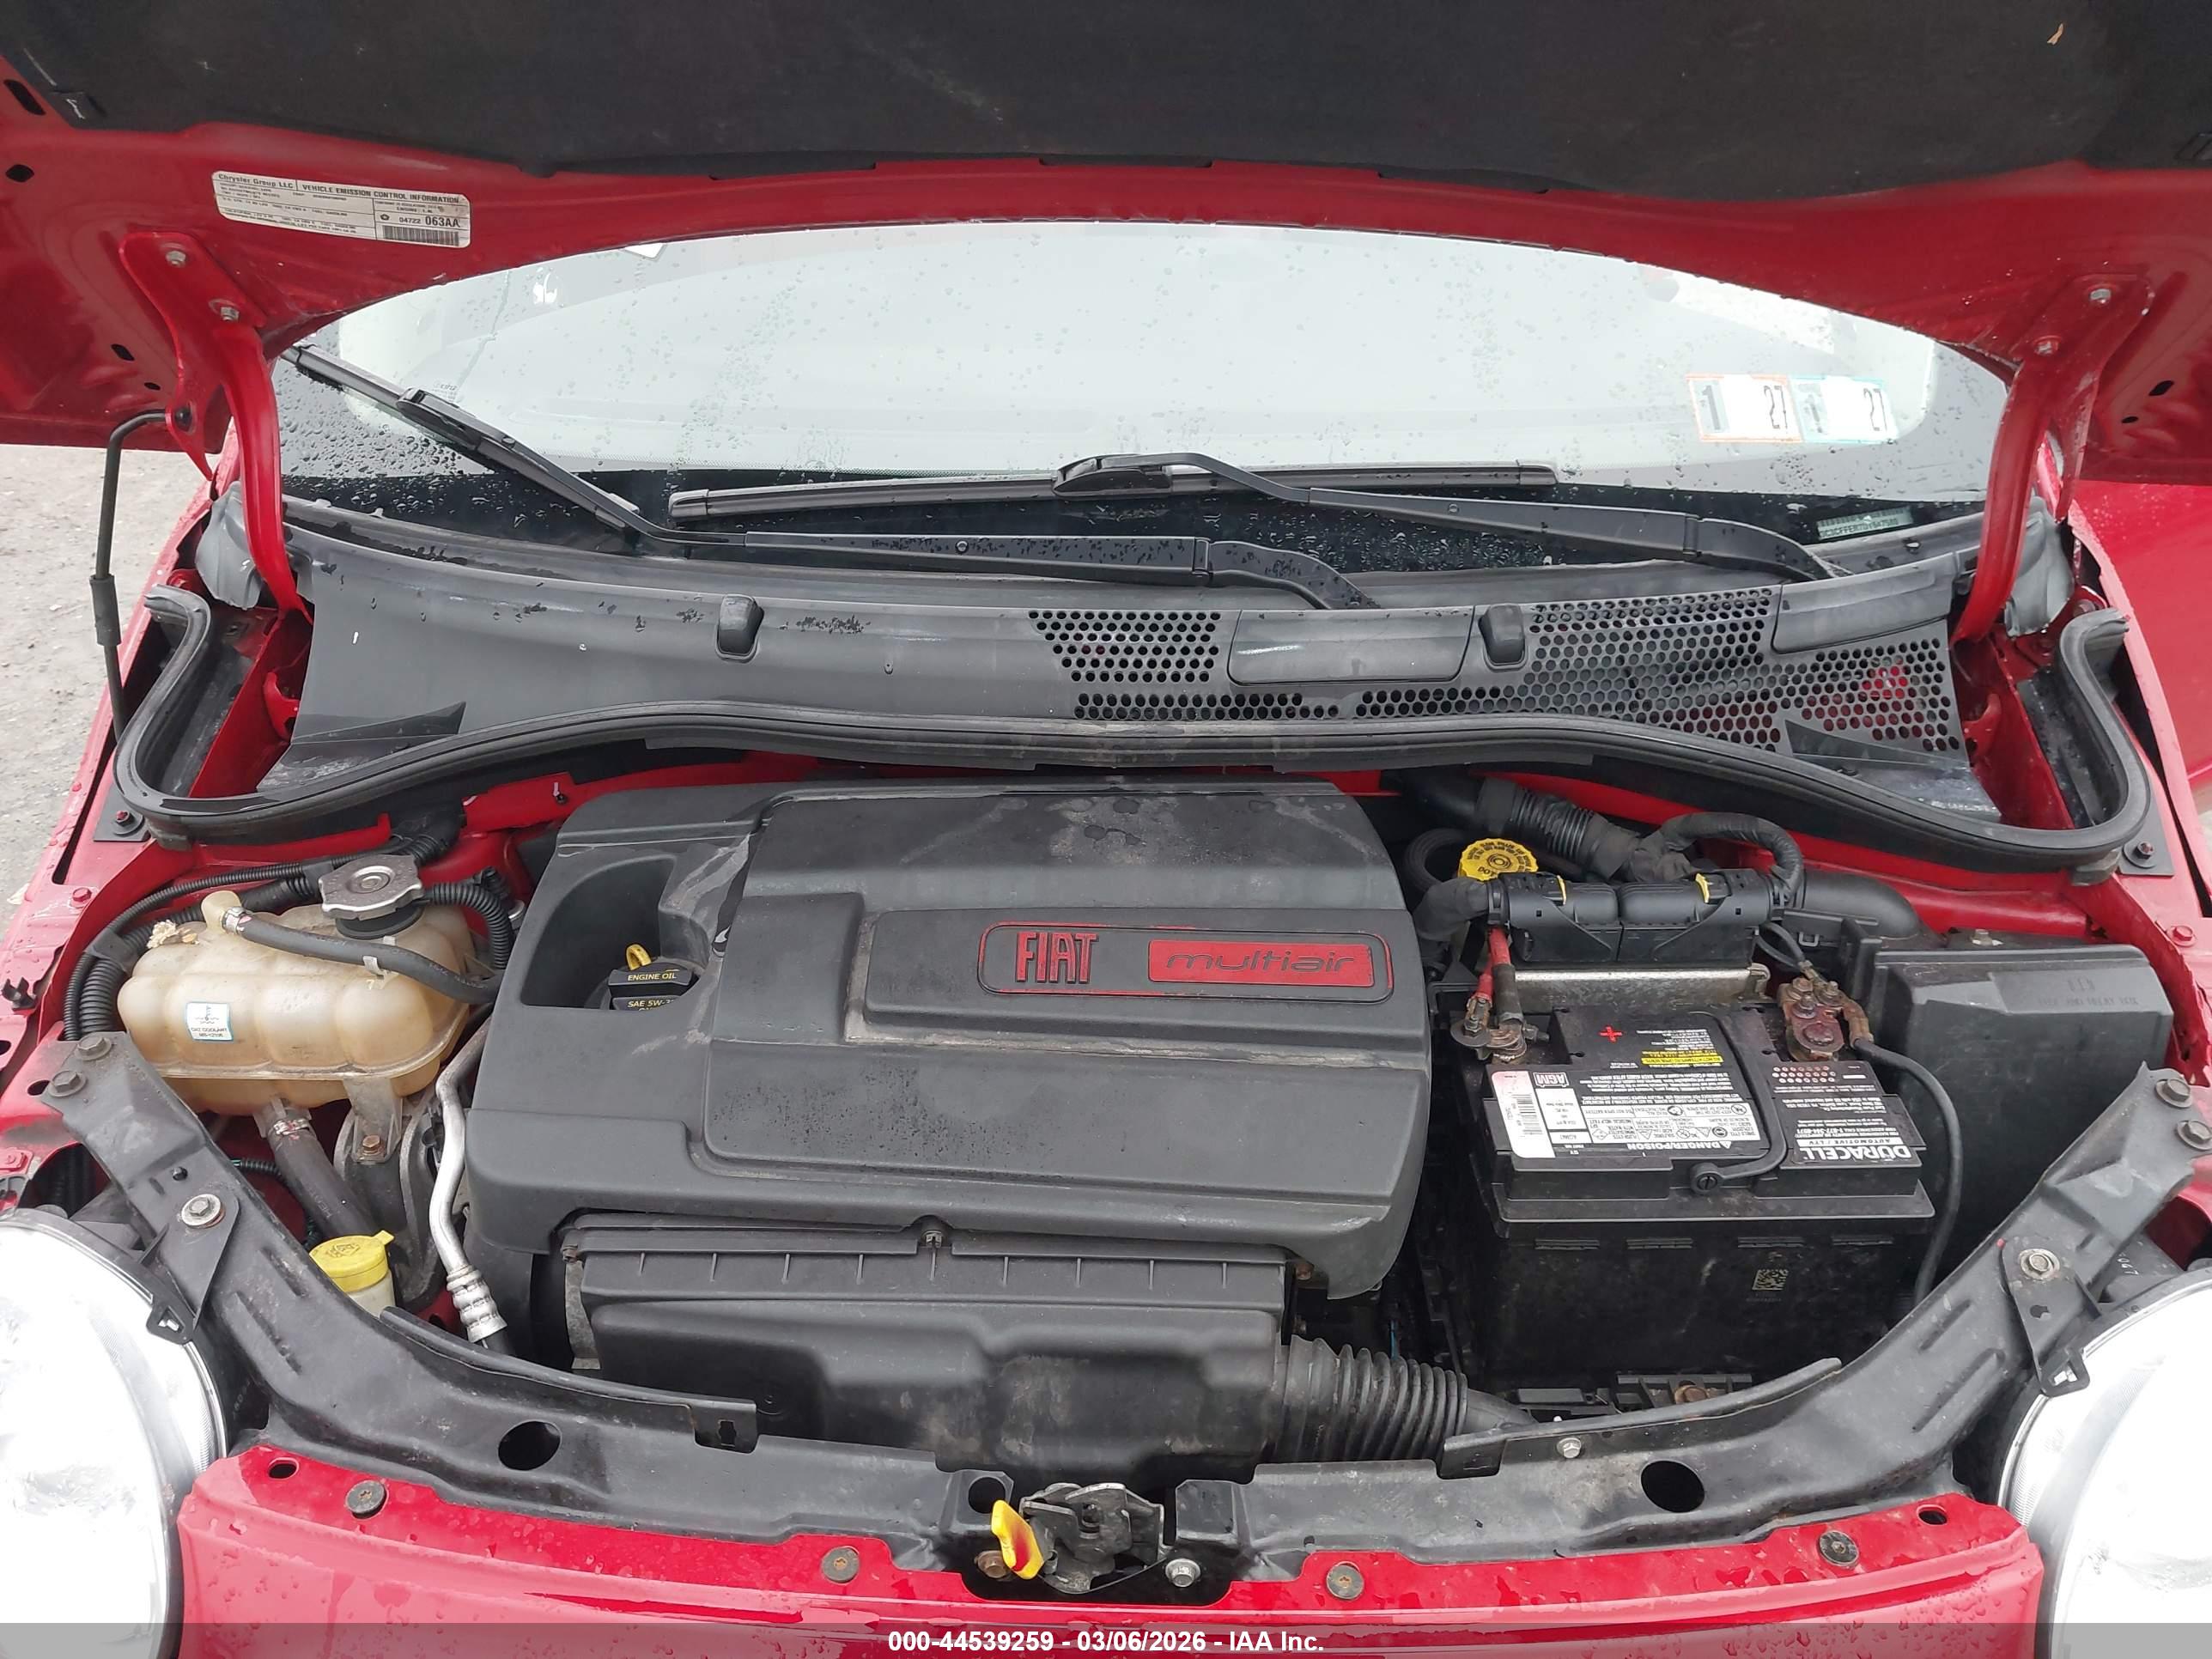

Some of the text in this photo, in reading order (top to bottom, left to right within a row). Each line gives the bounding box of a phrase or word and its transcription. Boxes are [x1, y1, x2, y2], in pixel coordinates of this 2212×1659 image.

[219, 173, 251, 183] Chrysler
[253, 179, 276, 187] Group
[337, 188, 371, 197] EMISSION
[410, 194, 459, 203] INFORMATION
[425, 216, 460, 228] 063AA
[1016, 932, 1355, 983] FIAT multiair
[1536, 1074, 1565, 1085] AGM
[1800, 1146, 1911, 1159] DURACELL
